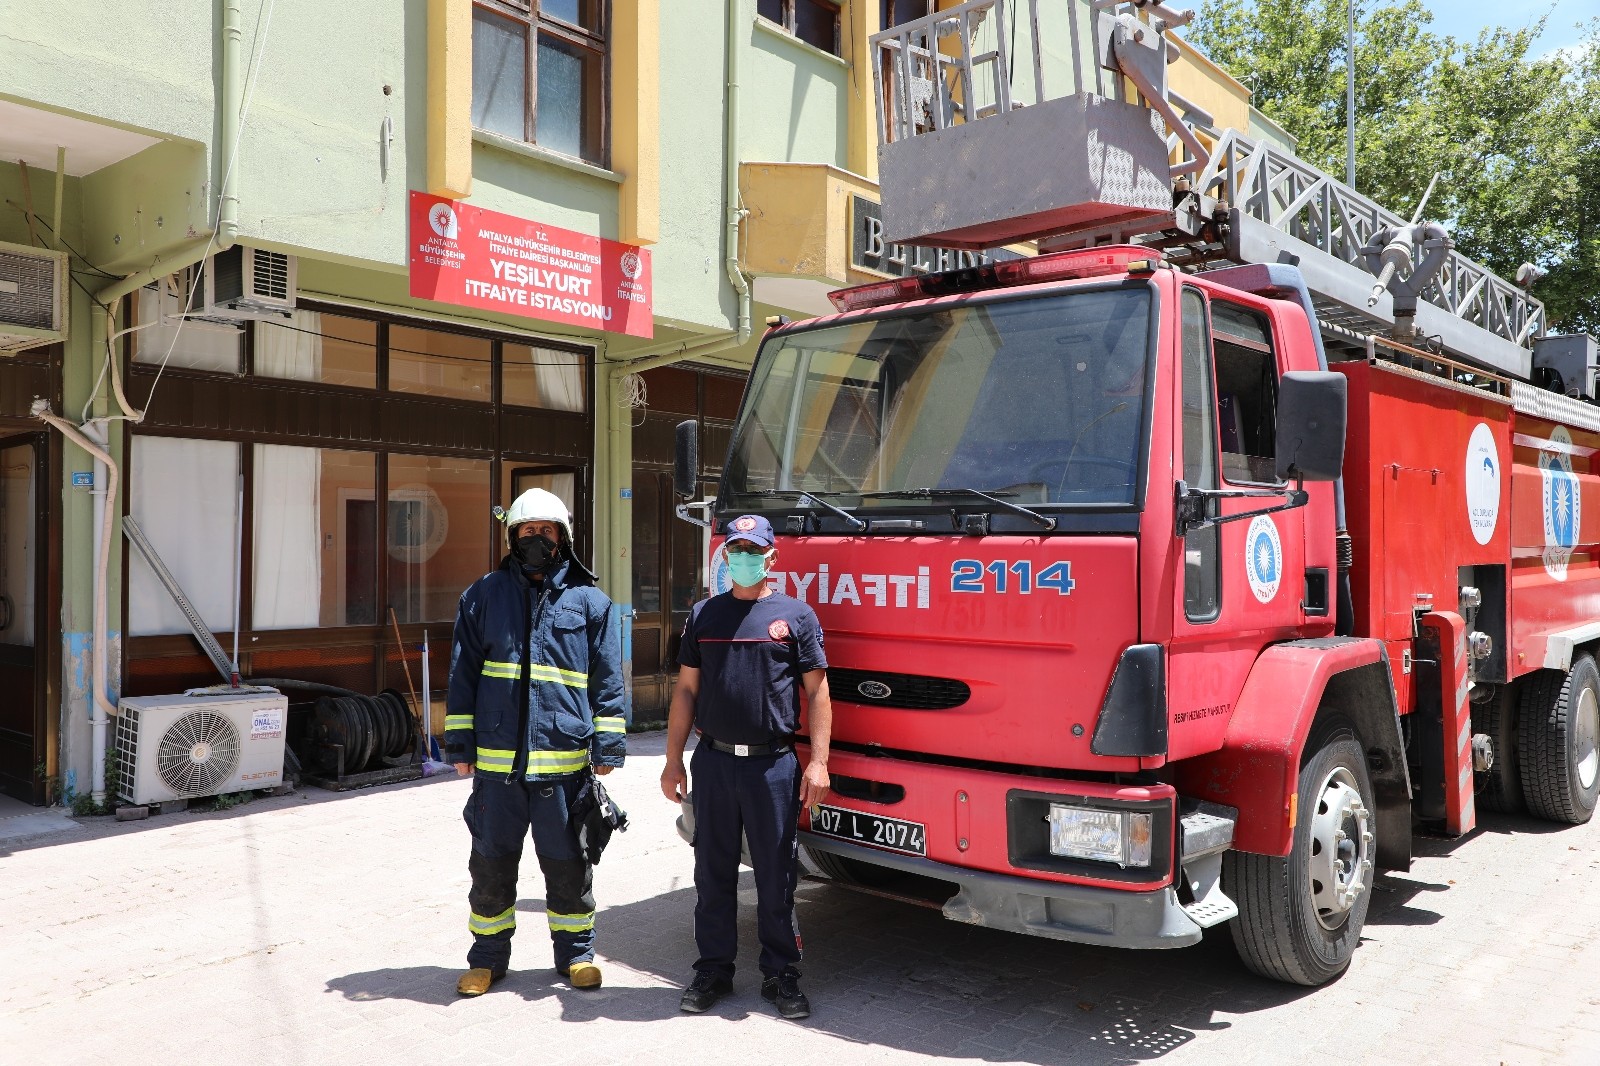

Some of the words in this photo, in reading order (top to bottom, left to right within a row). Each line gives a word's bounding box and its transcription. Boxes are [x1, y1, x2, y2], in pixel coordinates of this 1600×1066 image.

[428, 237, 458, 249] ANTALYA
[536, 231, 548, 242] T.C.
[420, 245, 466, 260] BÜYÜKŞEHİR
[478, 229, 513, 245] ANTALYA
[514, 235, 561, 255] BÜYÜKŞEHİR
[561, 247, 601, 265] BELEDİYESİ
[425, 256, 461, 269] BELEDİYESİ
[489, 241, 519, 258] İTFAİYE
[519, 247, 549, 264] DAİRESİ
[550, 257, 592, 273] BAŞKANLIĞI
[489, 258, 592, 297] YEŞİLYURT
[620, 281, 643, 291] ANTALYA
[465, 279, 527, 306] İTFAİYE
[530, 291, 613, 321] İSTASYONU
[617, 287, 646, 304] İTFAİYESİ
[950, 558, 1076, 596] 2114
[865, 685, 883, 695] Ford
[821, 809, 841, 832] 07
[852, 815, 863, 838] L
[873, 821, 921, 850] 2074
